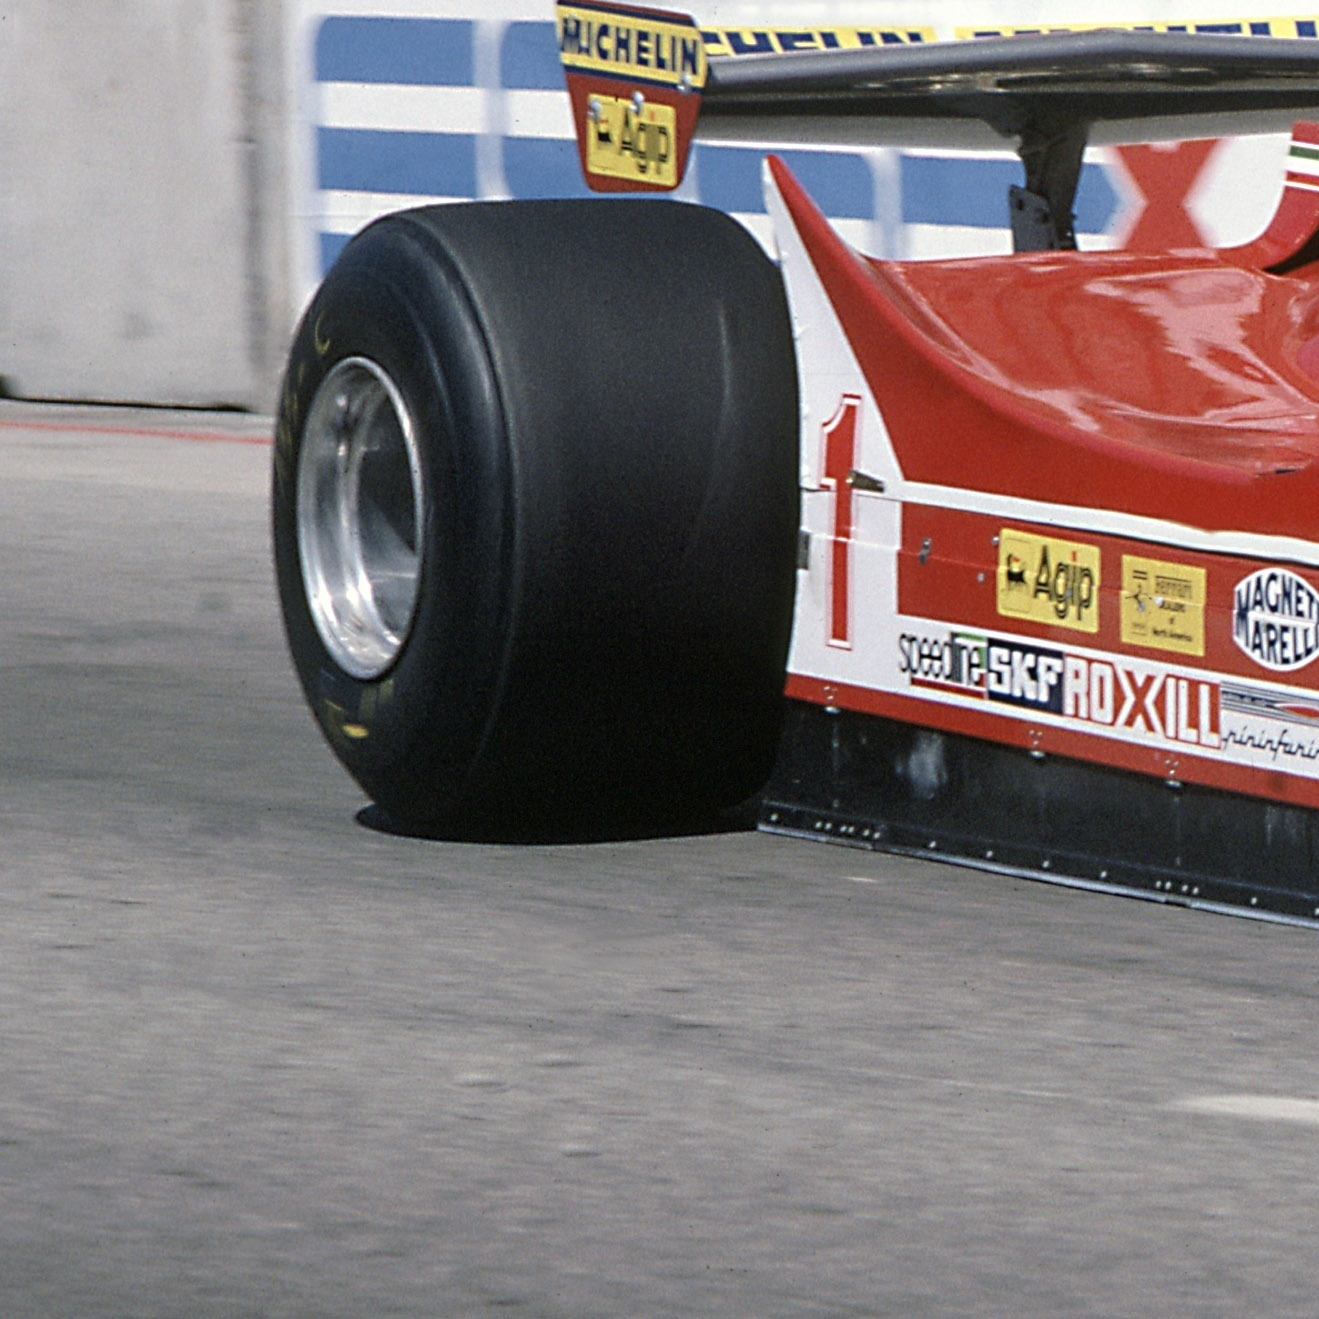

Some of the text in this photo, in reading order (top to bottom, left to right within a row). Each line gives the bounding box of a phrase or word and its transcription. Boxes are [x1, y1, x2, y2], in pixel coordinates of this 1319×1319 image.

[561, 16, 698, 76] MICHELIN
[1033, 545, 1094, 622] Agip
[988, 646, 1063, 703] SKF
[1064, 656, 1222, 749] ROXILL
